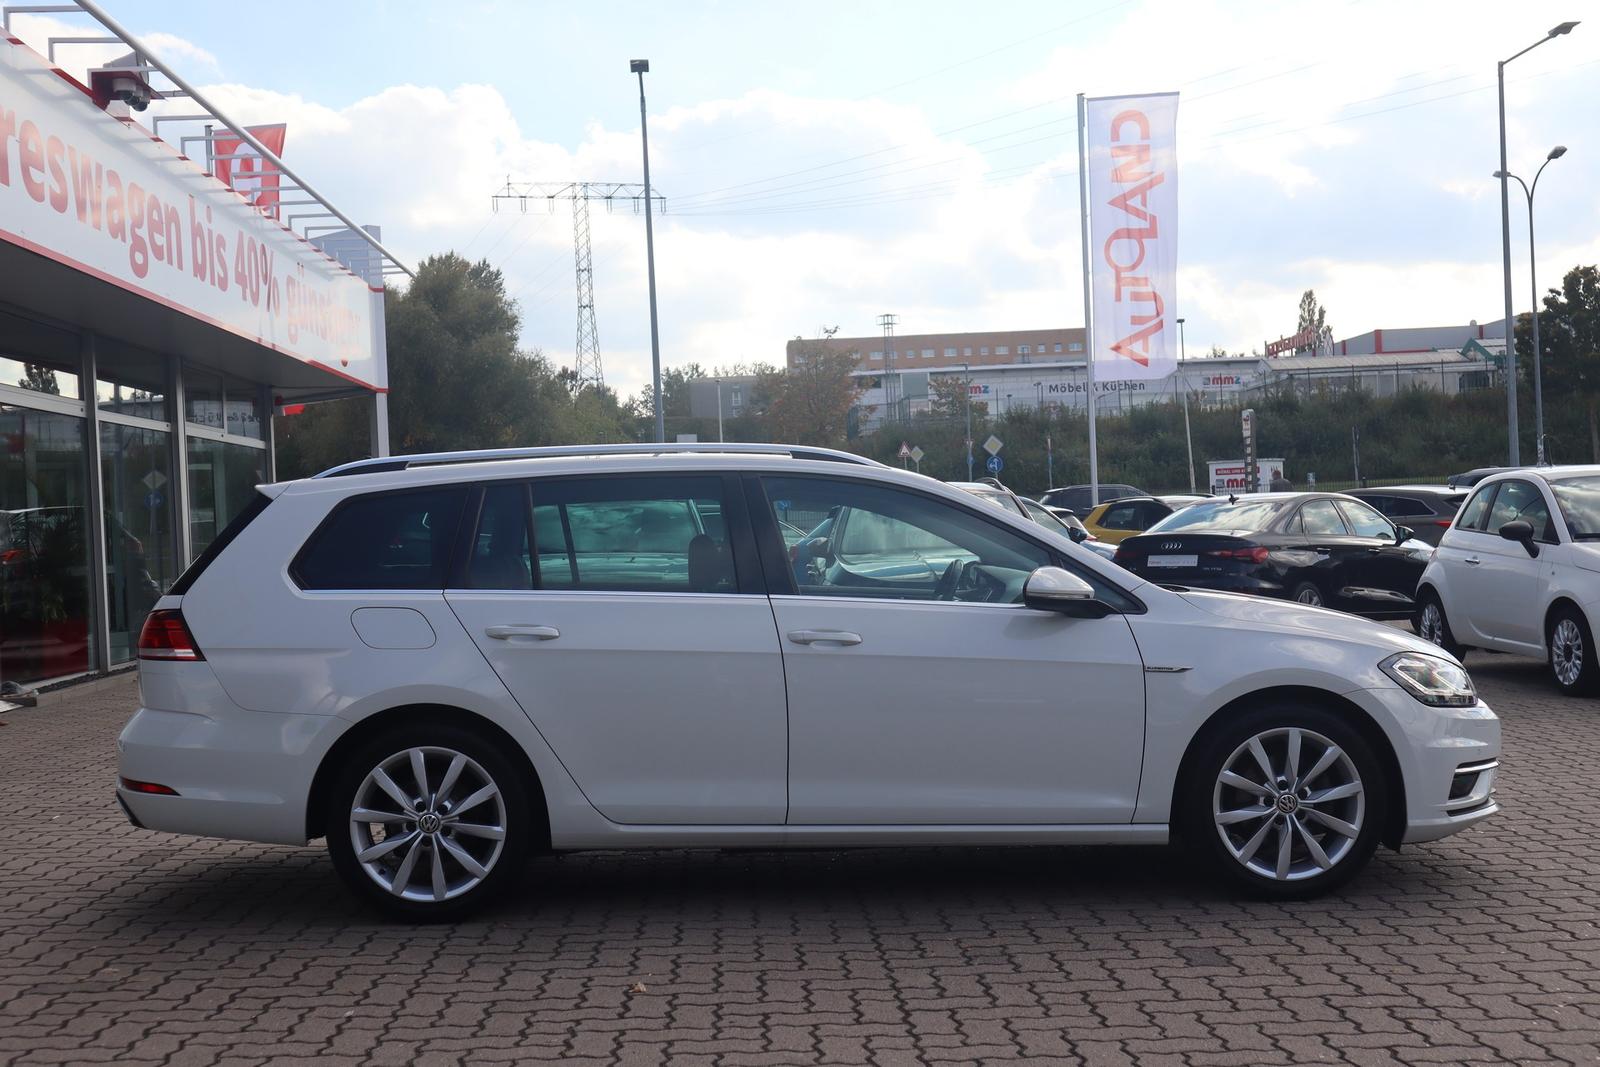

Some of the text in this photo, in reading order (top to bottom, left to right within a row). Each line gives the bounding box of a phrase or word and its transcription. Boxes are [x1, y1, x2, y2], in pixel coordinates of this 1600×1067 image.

[188, 194, 229, 292] bis
[234, 229, 281, 319] 40%
[1103, 109, 1165, 368] AUTOLAND
[1048, 381, 1088, 393] Möbel
[1102, 380, 1145, 392] Küchen
